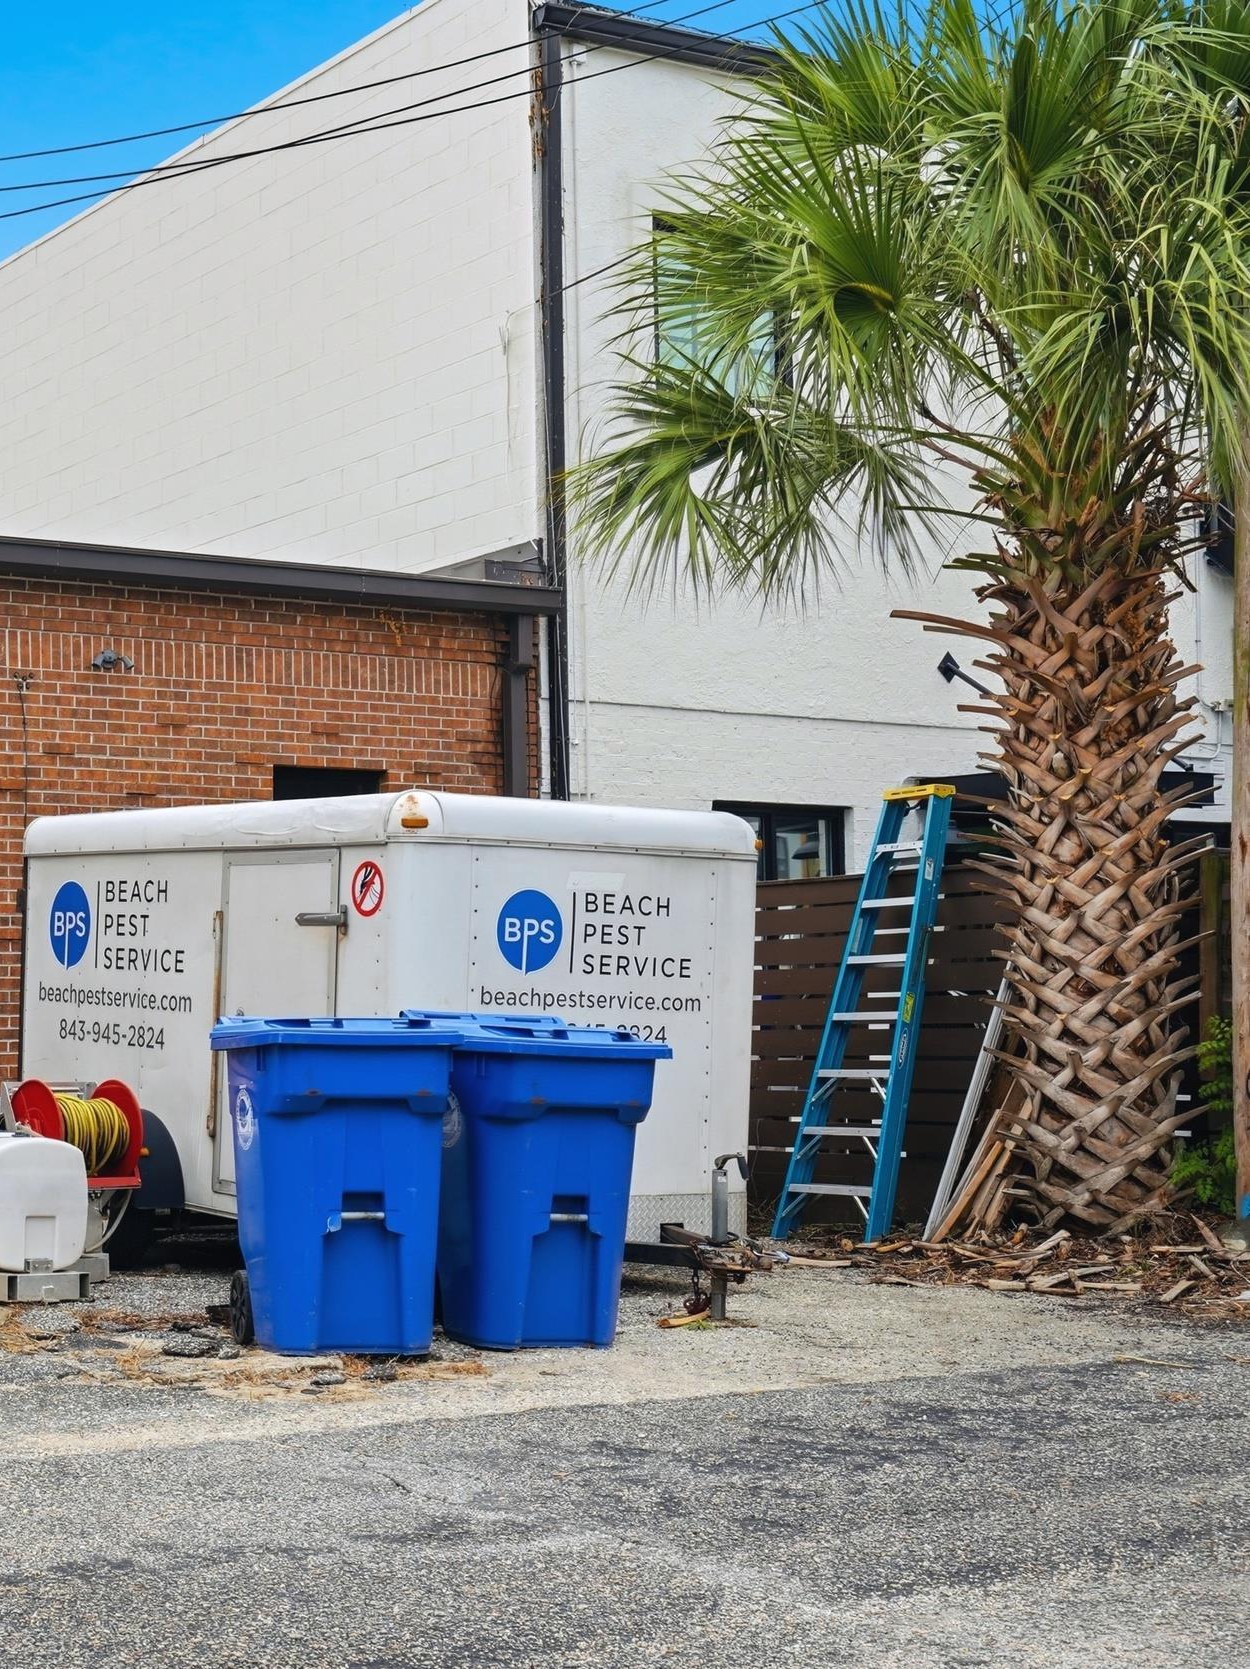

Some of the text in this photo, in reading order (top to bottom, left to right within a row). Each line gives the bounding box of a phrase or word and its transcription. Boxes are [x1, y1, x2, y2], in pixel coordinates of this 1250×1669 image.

[105, 880, 168, 903] BEACH
[584, 892, 670, 917] BEACH
[104, 914, 150, 937] PEST
[583, 923, 646, 945] PEST
[103, 947, 185, 973] SERVICE
[582, 954, 692, 978] SERVICE
[38, 981, 192, 1013] beachpestservice.com
[480, 986, 701, 1012] beachpestservice.com
[59, 1018, 165, 1050] 843-945-2824
